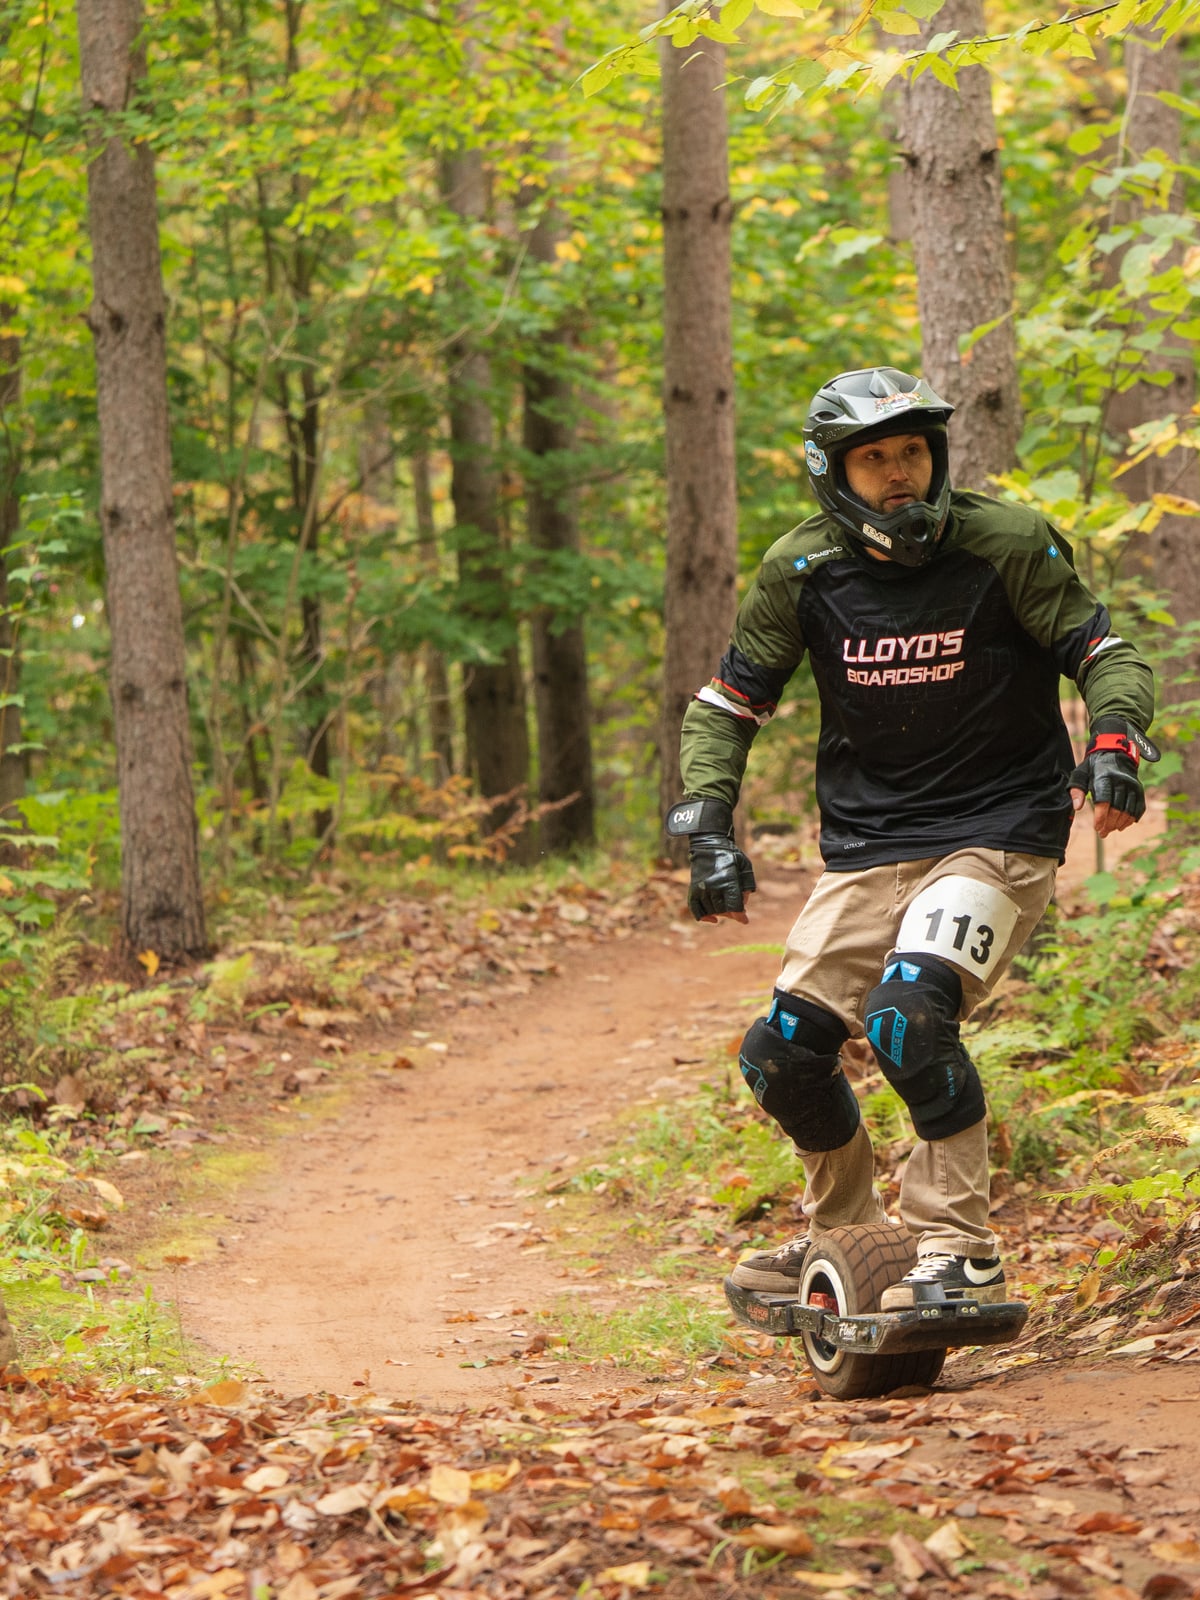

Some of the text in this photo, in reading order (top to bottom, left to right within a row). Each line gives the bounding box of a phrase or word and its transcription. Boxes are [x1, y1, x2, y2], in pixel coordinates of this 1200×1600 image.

[843, 629, 966, 663] LLOYD'S
[847, 660, 966, 686] BOARDSHOP
[925, 908, 994, 965] 113
